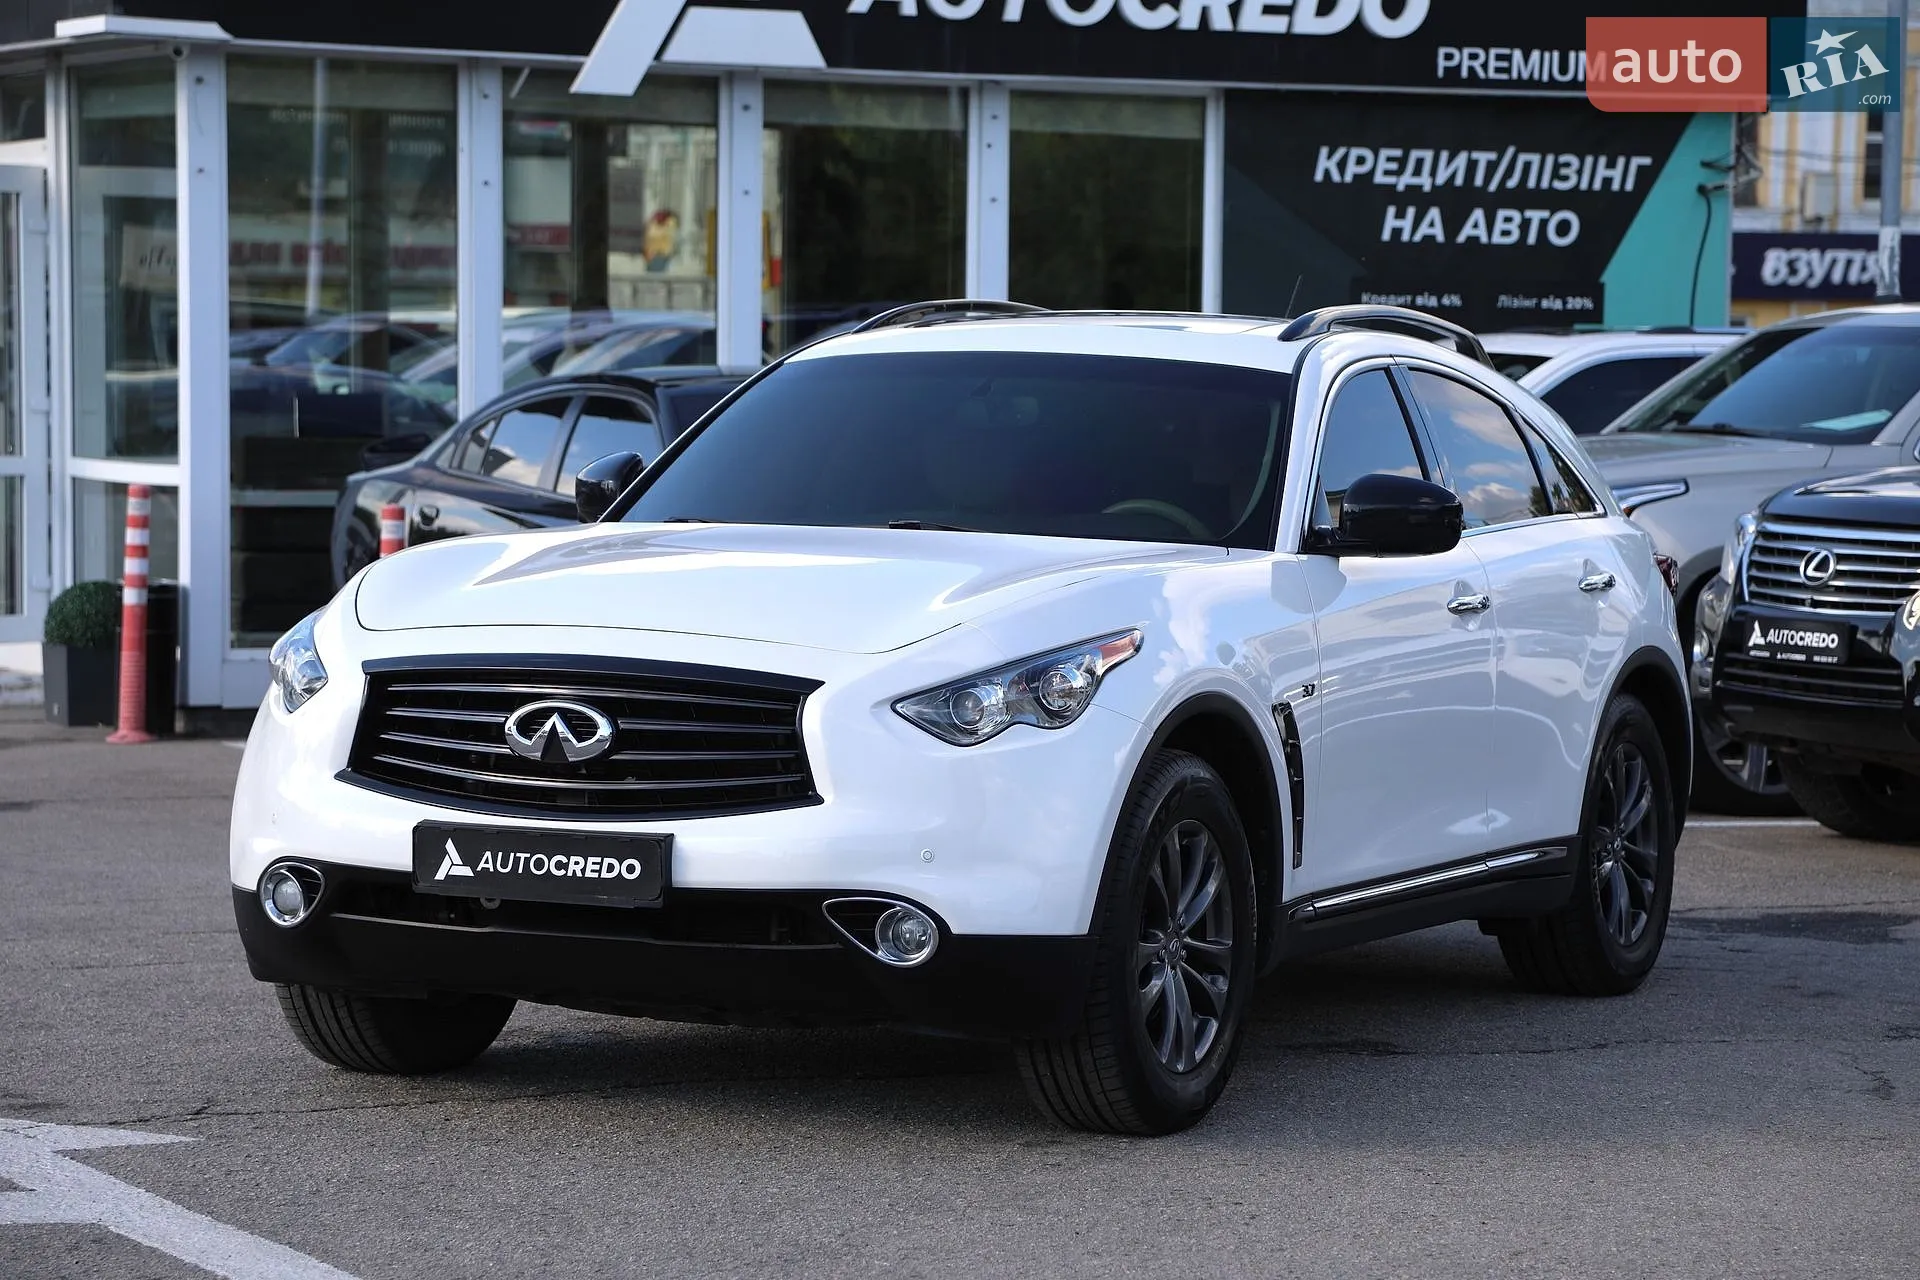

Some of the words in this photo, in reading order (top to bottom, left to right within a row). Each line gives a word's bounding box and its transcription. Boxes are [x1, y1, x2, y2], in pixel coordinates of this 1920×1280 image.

[1436, 46, 1607, 82] PREMIUM
[1313, 145, 1653, 193] КРЕДИТ/ЛІЗІНГ
[1380, 205, 1446, 243] НА
[1455, 207, 1581, 248] АВТО
[1766, 628, 1838, 648] AUTOCREDO
[476, 850, 642, 880] AUTOCREDO
